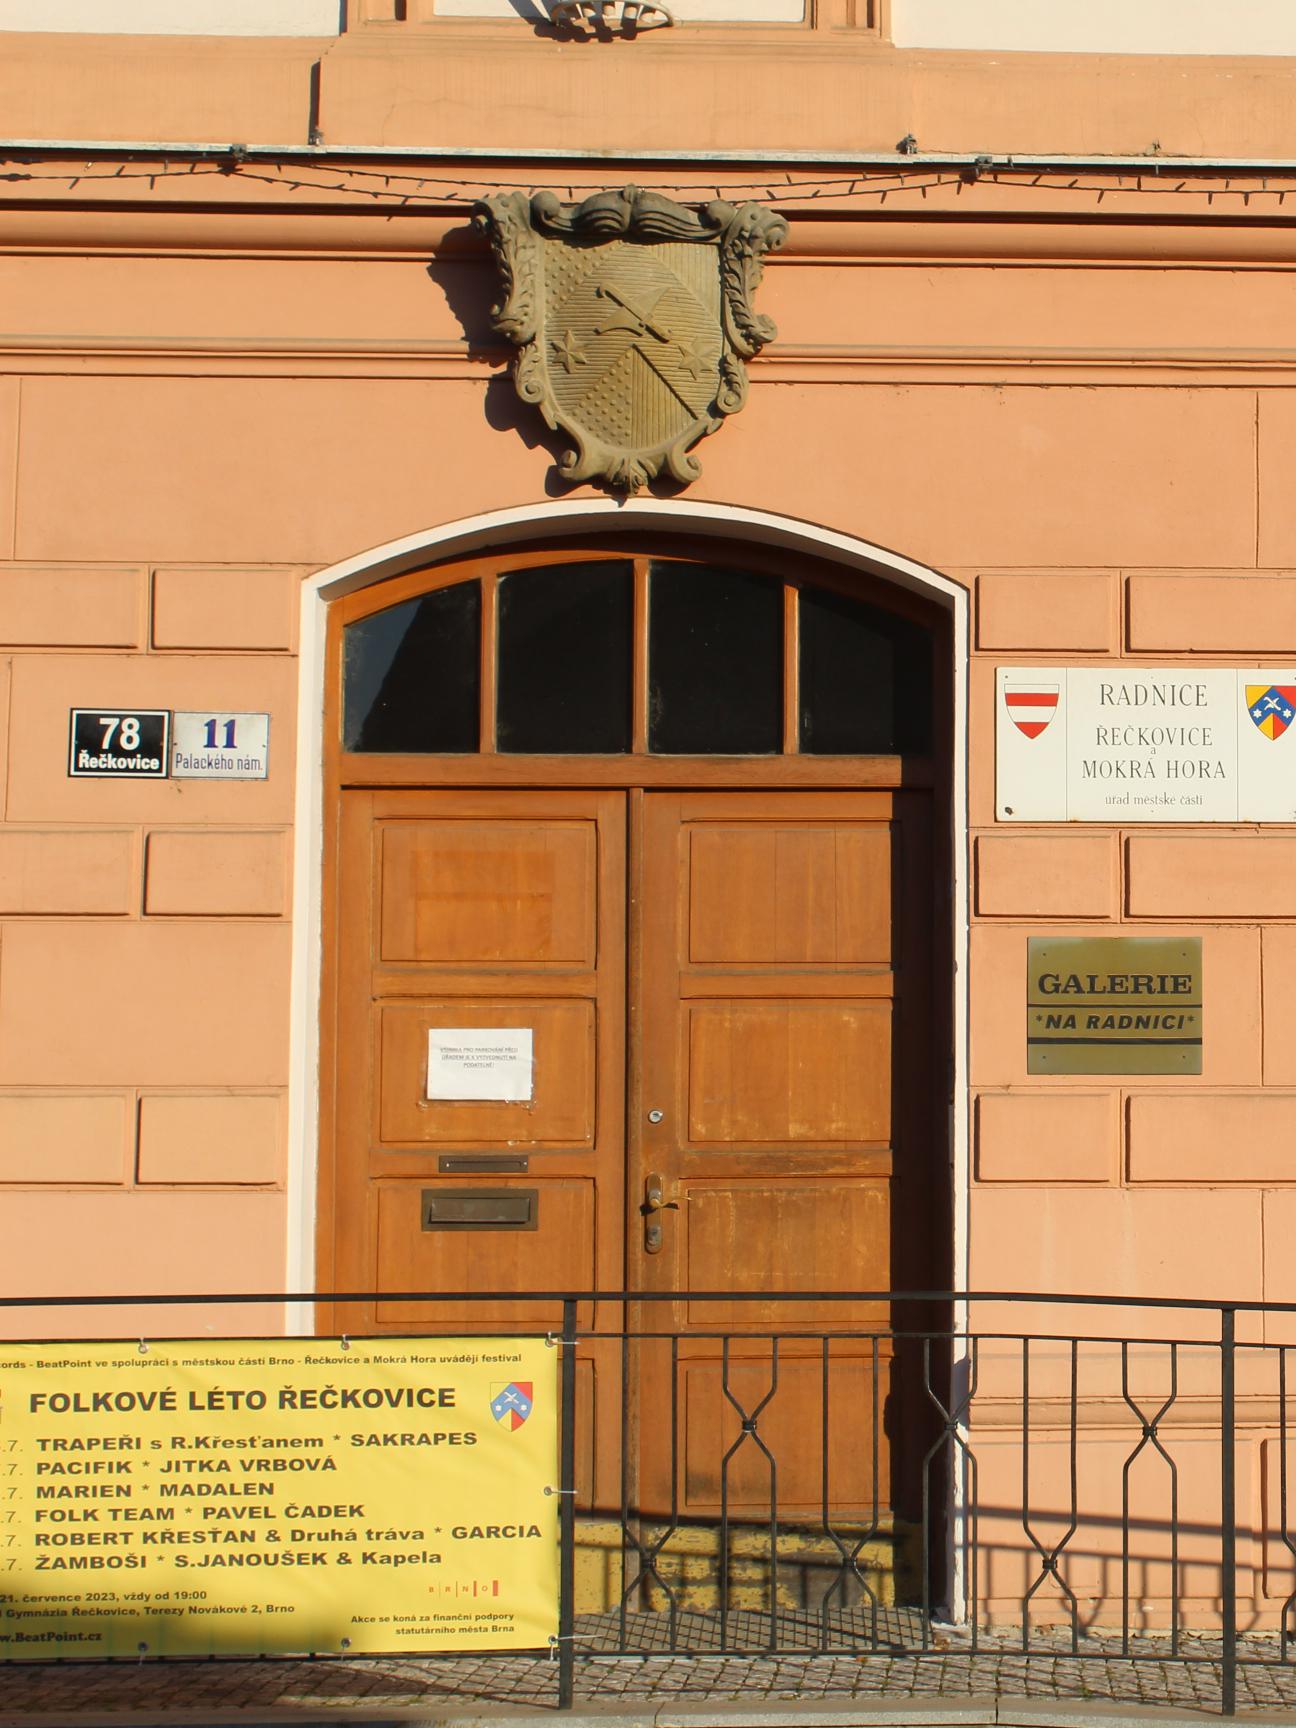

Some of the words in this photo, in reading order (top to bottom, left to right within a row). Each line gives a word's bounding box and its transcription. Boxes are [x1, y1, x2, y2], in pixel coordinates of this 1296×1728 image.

[1099, 683, 1208, 707] RADNICE
[99, 717, 140, 750] 78
[203, 718, 238, 749] 11
[1096, 724, 1213, 746] ŘEČKOVICE
[78, 750, 160, 770] Řečkovice
[1150, 747, 1157, 755] a
[175, 752, 234, 770] Palackého
[236, 753, 263, 771] nám.
[1082, 757, 1156, 779] MOKRÁ
[1167, 759, 1226, 779] HORA
[1038, 973, 1192, 995] GALERIE
[36, 1360, 92, 1369] BeatPoint
[112, 1358, 169, 1368] spolupráci
[182, 1358, 235, 1367] městskou
[238, 1357, 265, 1366] části
[269, 1357, 295, 1365] Brno
[304, 1355, 360, 1365] Řečkovice
[373, 1355, 407, 1364] Mokrá
[410, 1355, 436, 1364] Hora
[482, 1354, 522, 1363] festival
[30, 1387, 177, 1413] FOLKOVÉ
[189, 1386, 267, 1411] LÉTO
[278, 1384, 456, 1410] ŘEČKOVICE
[37, 1435, 141, 1451] TRAPEŘI
[150, 1440, 162, 1449] s
[350, 1433, 477, 1446] SAKRAPES
[37, 1461, 132, 1475] PACIFIK
[160, 1460, 231, 1473] JITKA
[240, 1455, 337, 1472] VRBOVÁ
[37, 1485, 131, 1498] MARIEN
[160, 1483, 274, 1496] MADALEN
[35, 1509, 98, 1522] FOLK
[109, 1508, 175, 1520] TEAM
[203, 1506, 276, 1519] PAVEL
[285, 1503, 365, 1518] ČADEK
[35, 1532, 133, 1546] ROBERT
[143, 1528, 255, 1544] KŘESŤAN
[265, 1530, 281, 1542] &
[291, 1529, 357, 1541] Druhá
[366, 1528, 424, 1540] tráva
[452, 1525, 541, 1539] GARCIA
[35, 1554, 147, 1570] ŽAMBOŠI
[175, 1551, 327, 1568] S.JANOUŠEK
[336, 1552, 352, 1565] &
[362, 1551, 442, 1567] Kapela
[23, 1594, 81, 1602] července
[86, 1592, 119, 1602] 2023,
[124, 1591, 150, 1602] vždy
[155, 1591, 169, 1600] od
[174, 1591, 207, 1600] 19:00
[6, 1609, 67, 1619] Gymnázia
[72, 1607, 140, 1617] Řečkovice,
[144, 1606, 184, 1616] Terezy
[189, 1605, 247, 1614] Novákové
[251, 1605, 262, 1614] 2,
[267, 1604, 295, 1613] Brno
[351, 1615, 376, 1623] Akce
[393, 1614, 416, 1622] koná
[433, 1613, 472, 1621] finanční
[475, 1613, 514, 1622] podpory
[396, 1626, 456, 1635] statutárního
[459, 1625, 489, 1633] města
